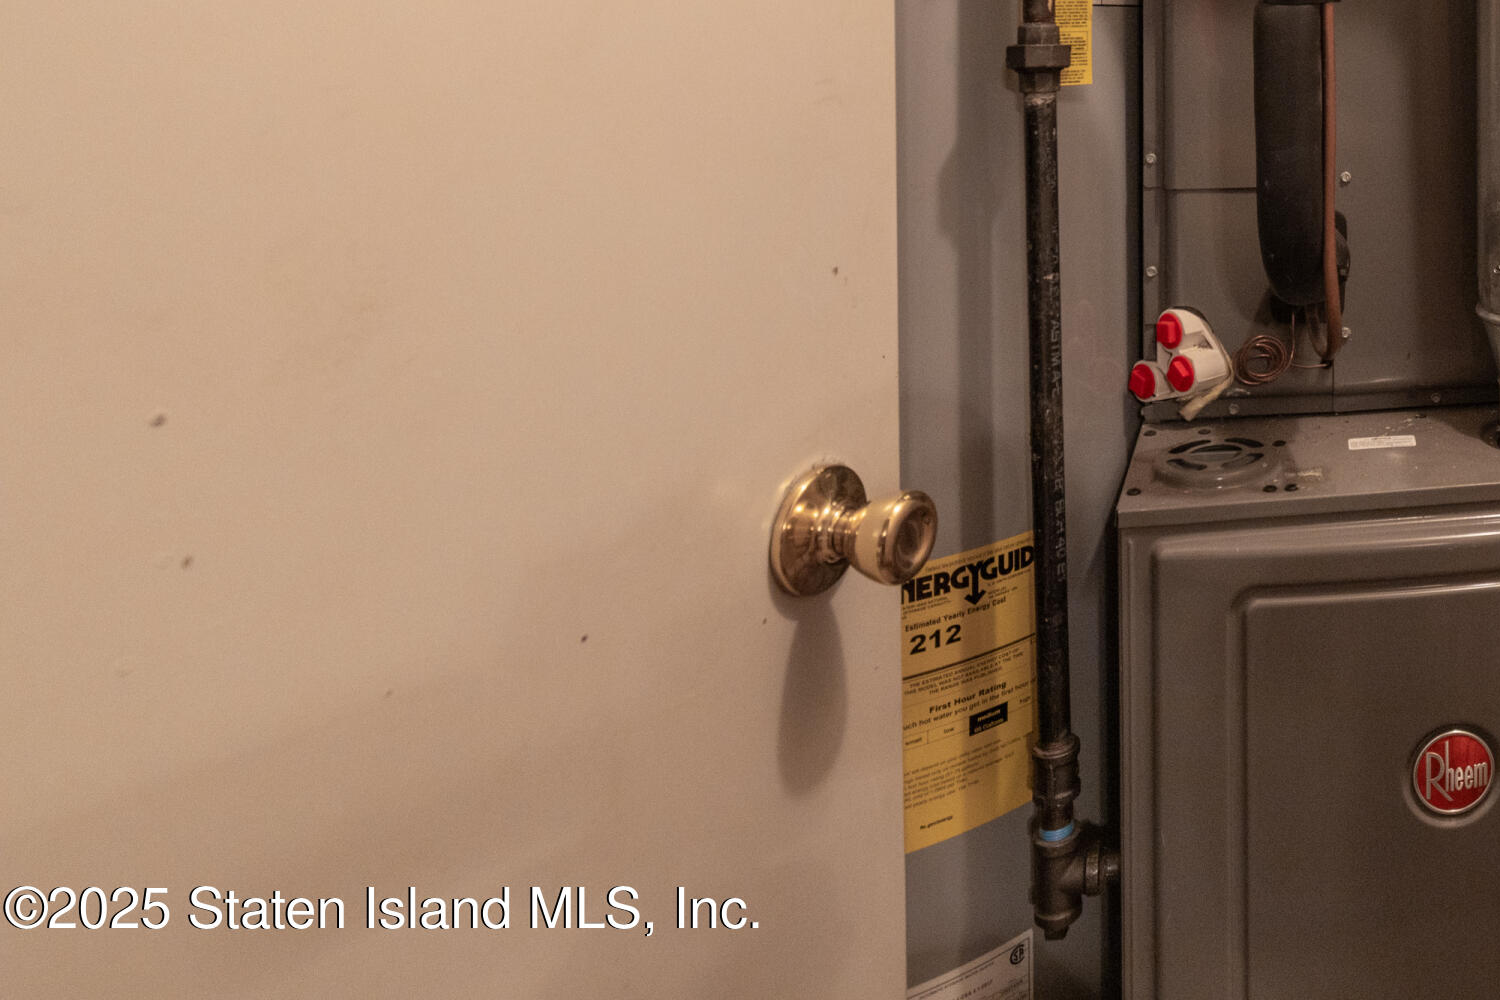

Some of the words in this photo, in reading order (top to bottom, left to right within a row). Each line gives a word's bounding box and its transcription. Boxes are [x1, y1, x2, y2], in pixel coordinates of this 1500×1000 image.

[905, 617, 940, 631] Estimated
[943, 610, 964, 621] Yearly
[967, 602, 990, 614] Energy
[910, 624, 960, 654] 212
[918, 717, 930, 725] hot
[933, 710, 952, 721] water
[954, 706, 967, 714] you
[989, 692, 999, 700] the
[1001, 687, 1013, 696] first
[929, 701, 951, 713] First
[953, 693, 976, 704] Hour
[978, 682, 1006, 696] Rating
[1426, 740, 1488, 801] Rheem
